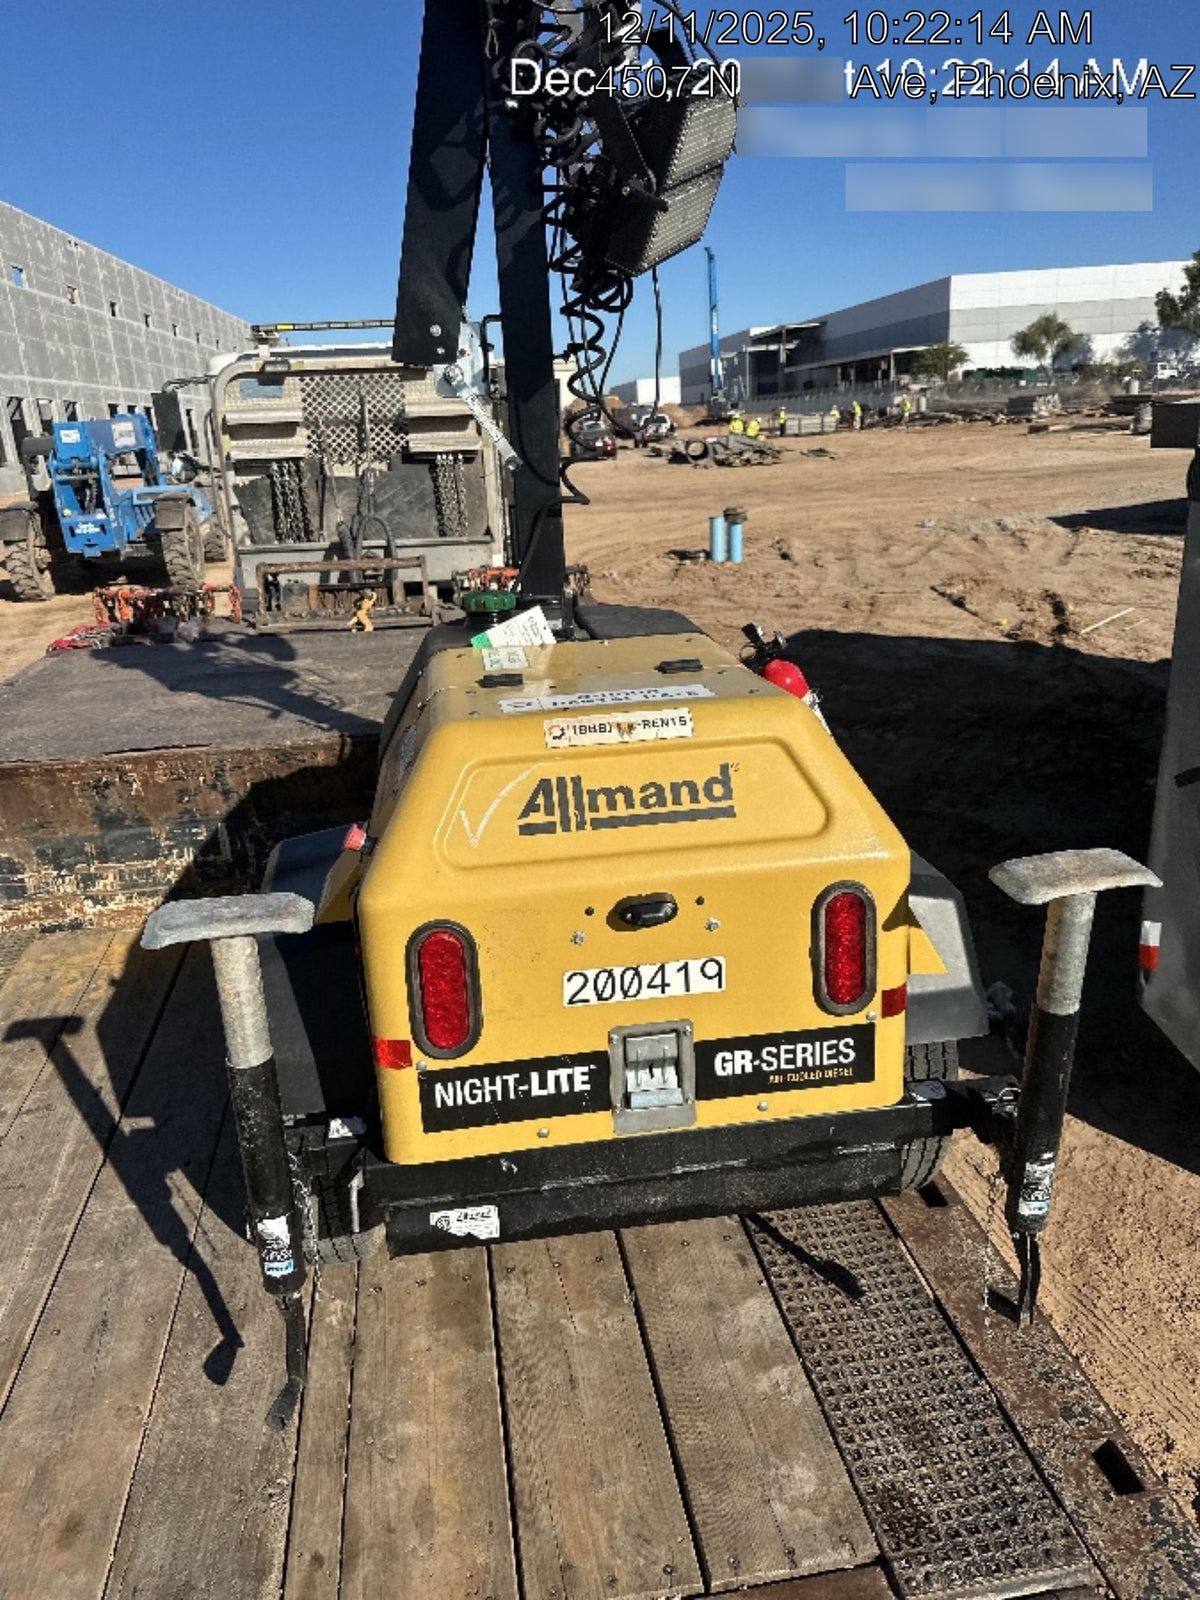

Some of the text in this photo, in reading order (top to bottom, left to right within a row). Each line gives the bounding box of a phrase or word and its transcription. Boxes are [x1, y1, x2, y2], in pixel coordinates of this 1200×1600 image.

[517, 763, 734, 833] Allmand
[566, 957, 723, 1005] 200419
[714, 1037, 856, 1077] GR-SERIES
[434, 1066, 592, 1109] NIGHT-LITE
